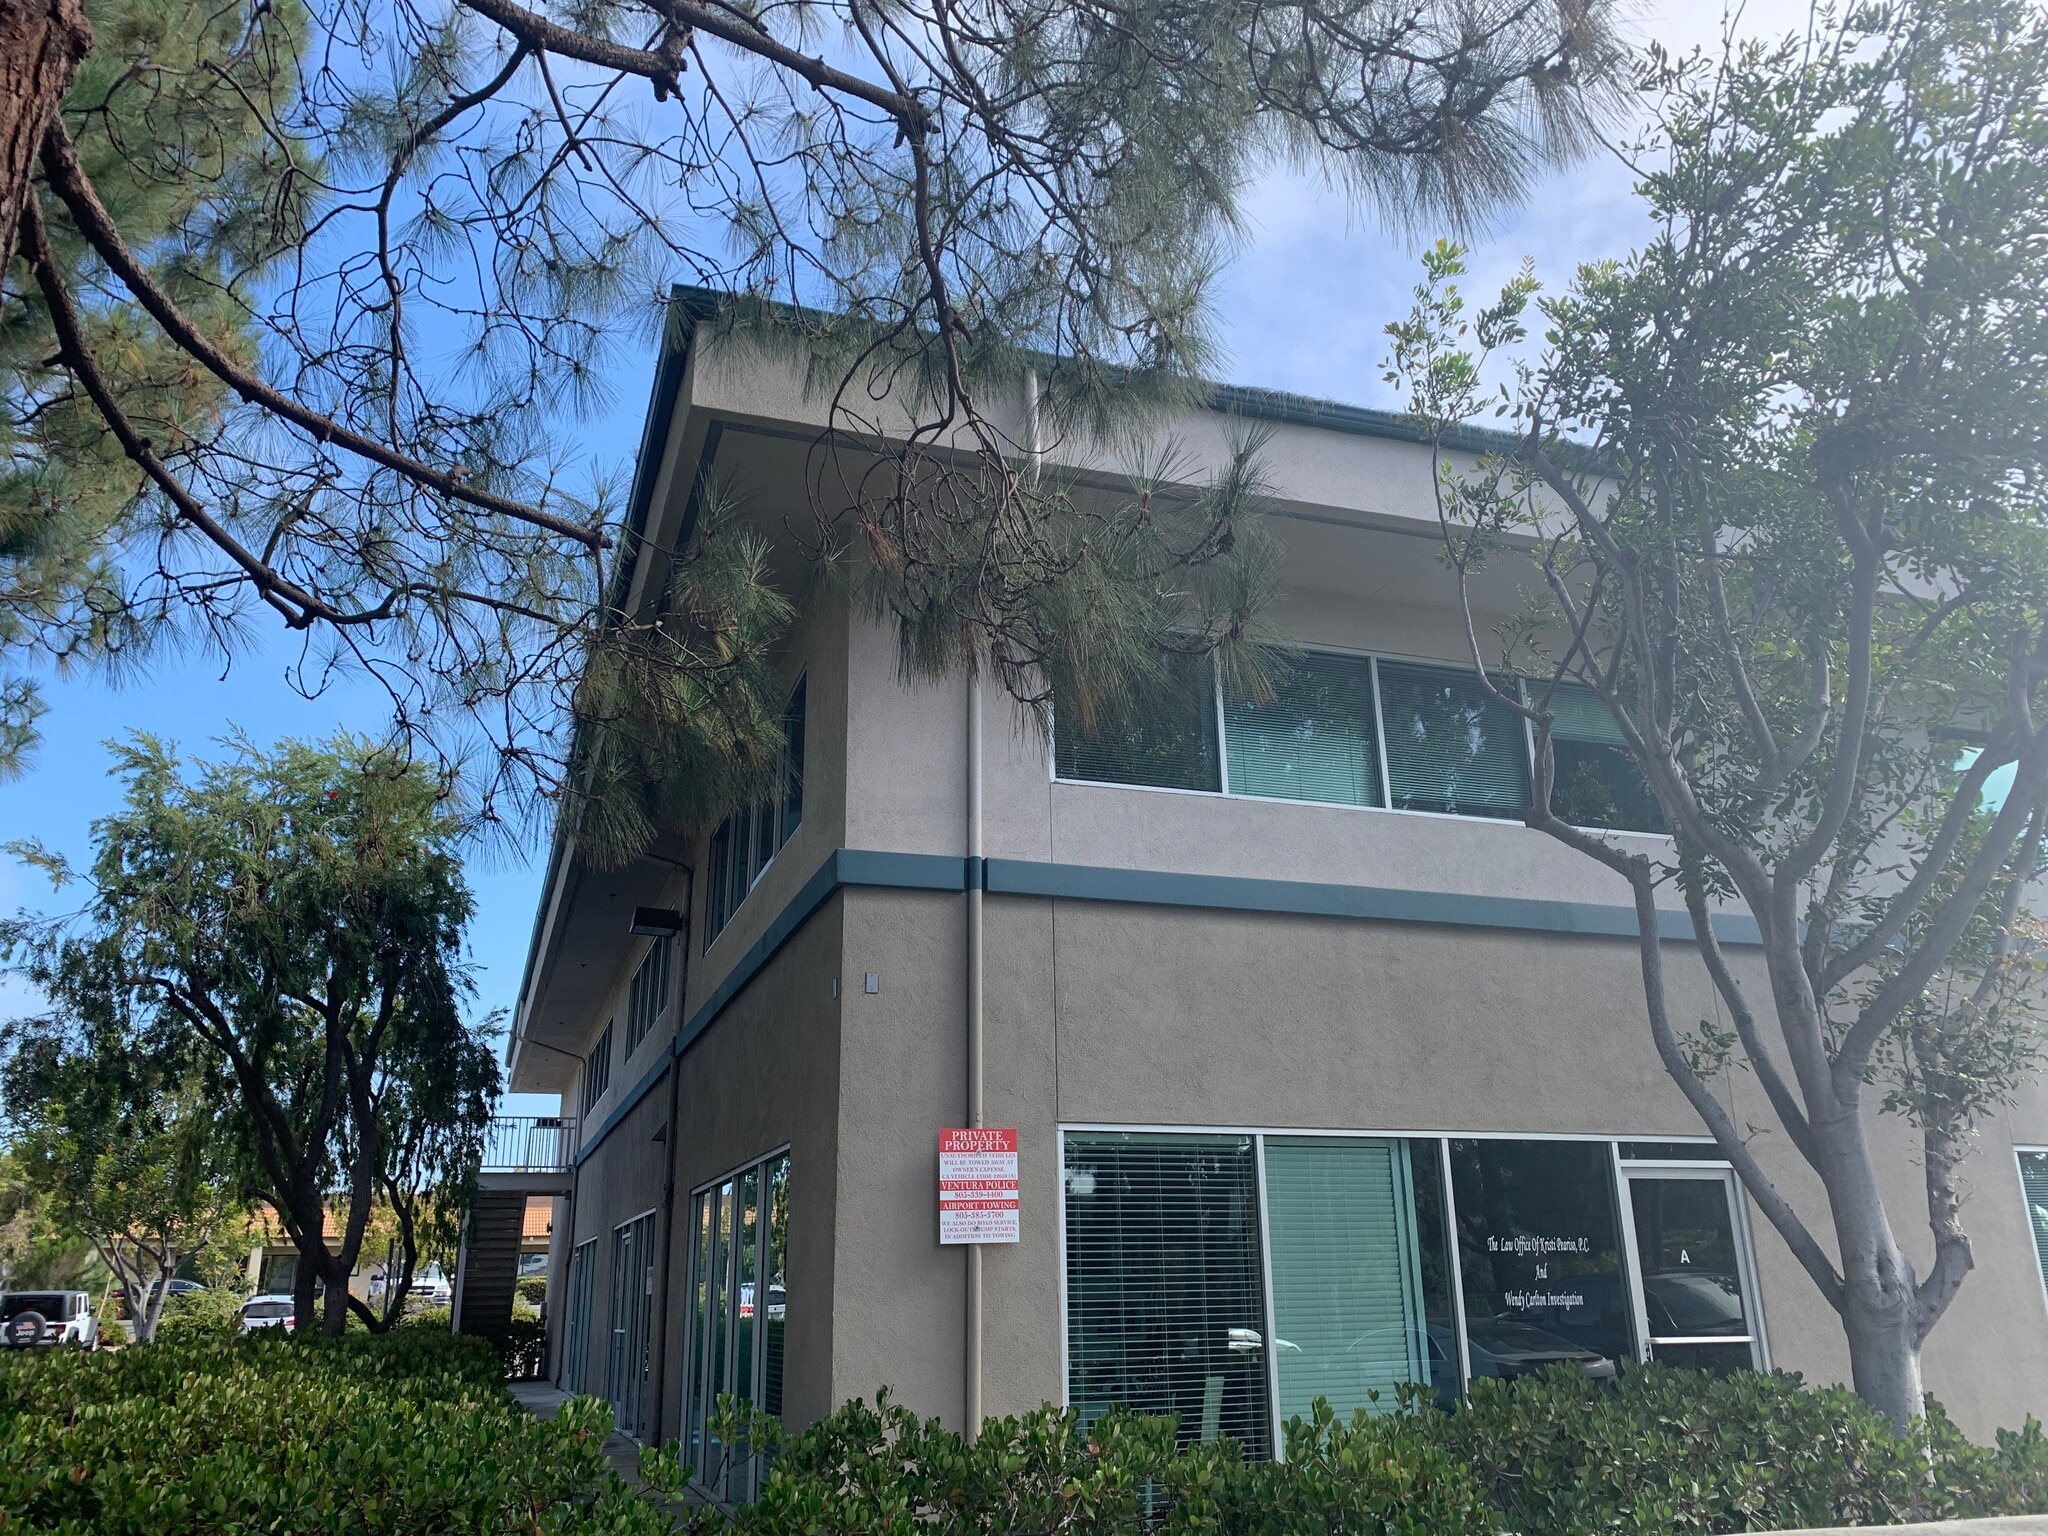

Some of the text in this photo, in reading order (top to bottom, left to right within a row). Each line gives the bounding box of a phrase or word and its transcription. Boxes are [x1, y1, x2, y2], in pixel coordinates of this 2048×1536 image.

[952, 1131, 1003, 1140] PRIVATE
[945, 1141, 1010, 1150] PROPERTY
[942, 1182, 983, 1190] VENTURA
[1487, 1236, 1498, 1251] The
[1501, 1238, 1513, 1251] Law
[1514, 1236, 1531, 1256] Office
[1532, 1236, 1539, 1256] Of
[1540, 1237, 1556, 1253] Kristi
[1578, 1238, 1590, 1252] P.C.
[1681, 1250, 1690, 1264] A
[1535, 1263, 1548, 1280] And
[1505, 1290, 1524, 1311] Wendy
[1548, 1291, 1584, 1310] Investigation
